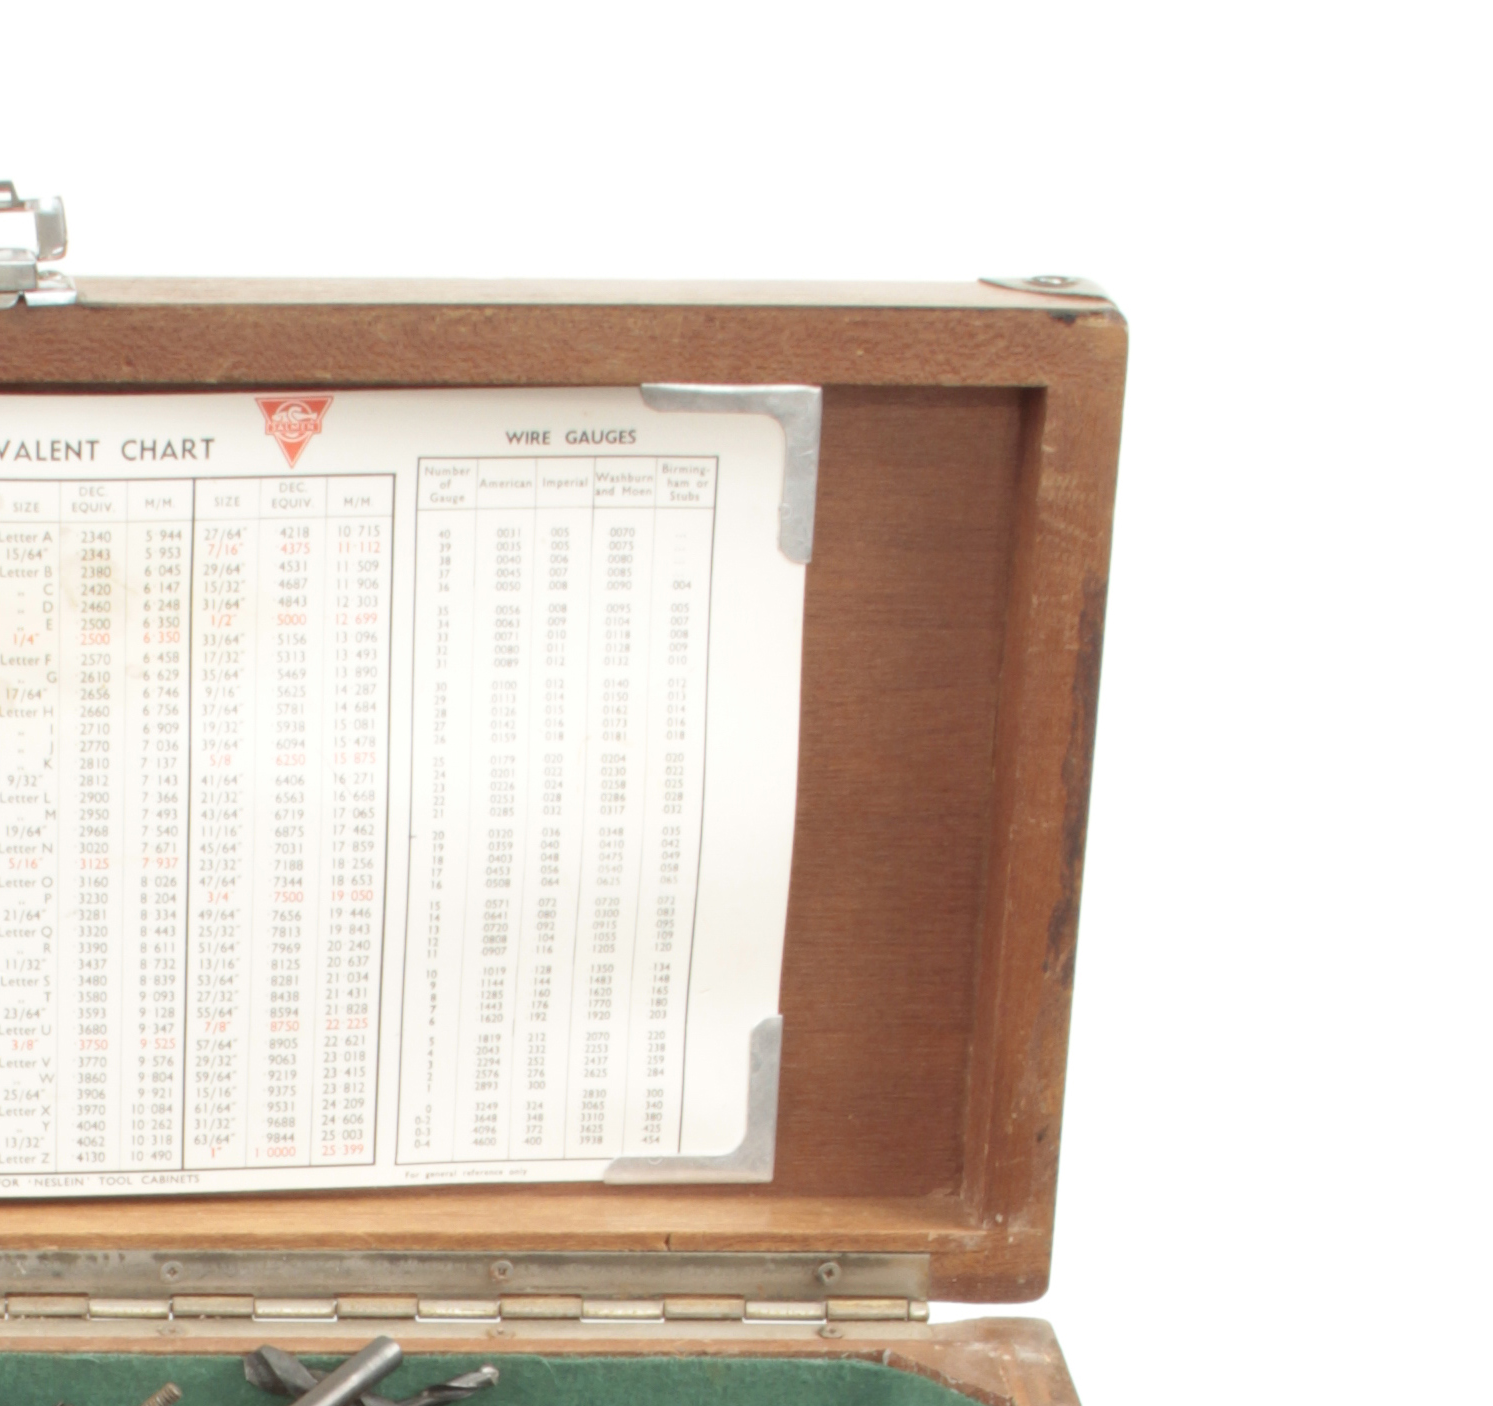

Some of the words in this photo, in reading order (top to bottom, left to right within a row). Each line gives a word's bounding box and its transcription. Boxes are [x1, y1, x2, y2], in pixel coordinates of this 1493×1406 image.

[505, 430, 551, 446] WIRE
[565, 429, 637, 445] GAUGES
[120, 436, 216, 461] CHART
[424, 466, 471, 477] Number
[479, 479, 532, 489] American
[542, 477, 588, 489] Imperial
[595, 472, 654, 484] Washburn
[667, 479, 690, 489] ham
[279, 482, 307, 494] DEC.
[440, 479, 452, 490] of
[79, 486, 107, 497] DEC.
[595, 487, 615, 497] and
[621, 486, 652, 497] Moen
[670, 491, 700, 502] Stubs
[214, 496, 241, 508] SIZE
[271, 498, 316, 509] EQUIV.
[430, 493, 466, 505] Gauge
[12, 502, 41, 514] SIZE
[71, 503, 116, 514] EQUIV.
[42, 531, 53, 544] A
[0, 566, 39, 579] Letter
[44, 566, 53, 579] B
[0, 654, 41, 667] Letter
[43, 706, 54, 718] H
[42, 842, 53, 854] N
[99, 1175, 133, 1186] TOOL
[141, 1173, 200, 1185] CABINETS
[425, 1168, 458, 1181] general
[462, 1168, 504, 1178] reference
[508, 1167, 528, 1178] only
